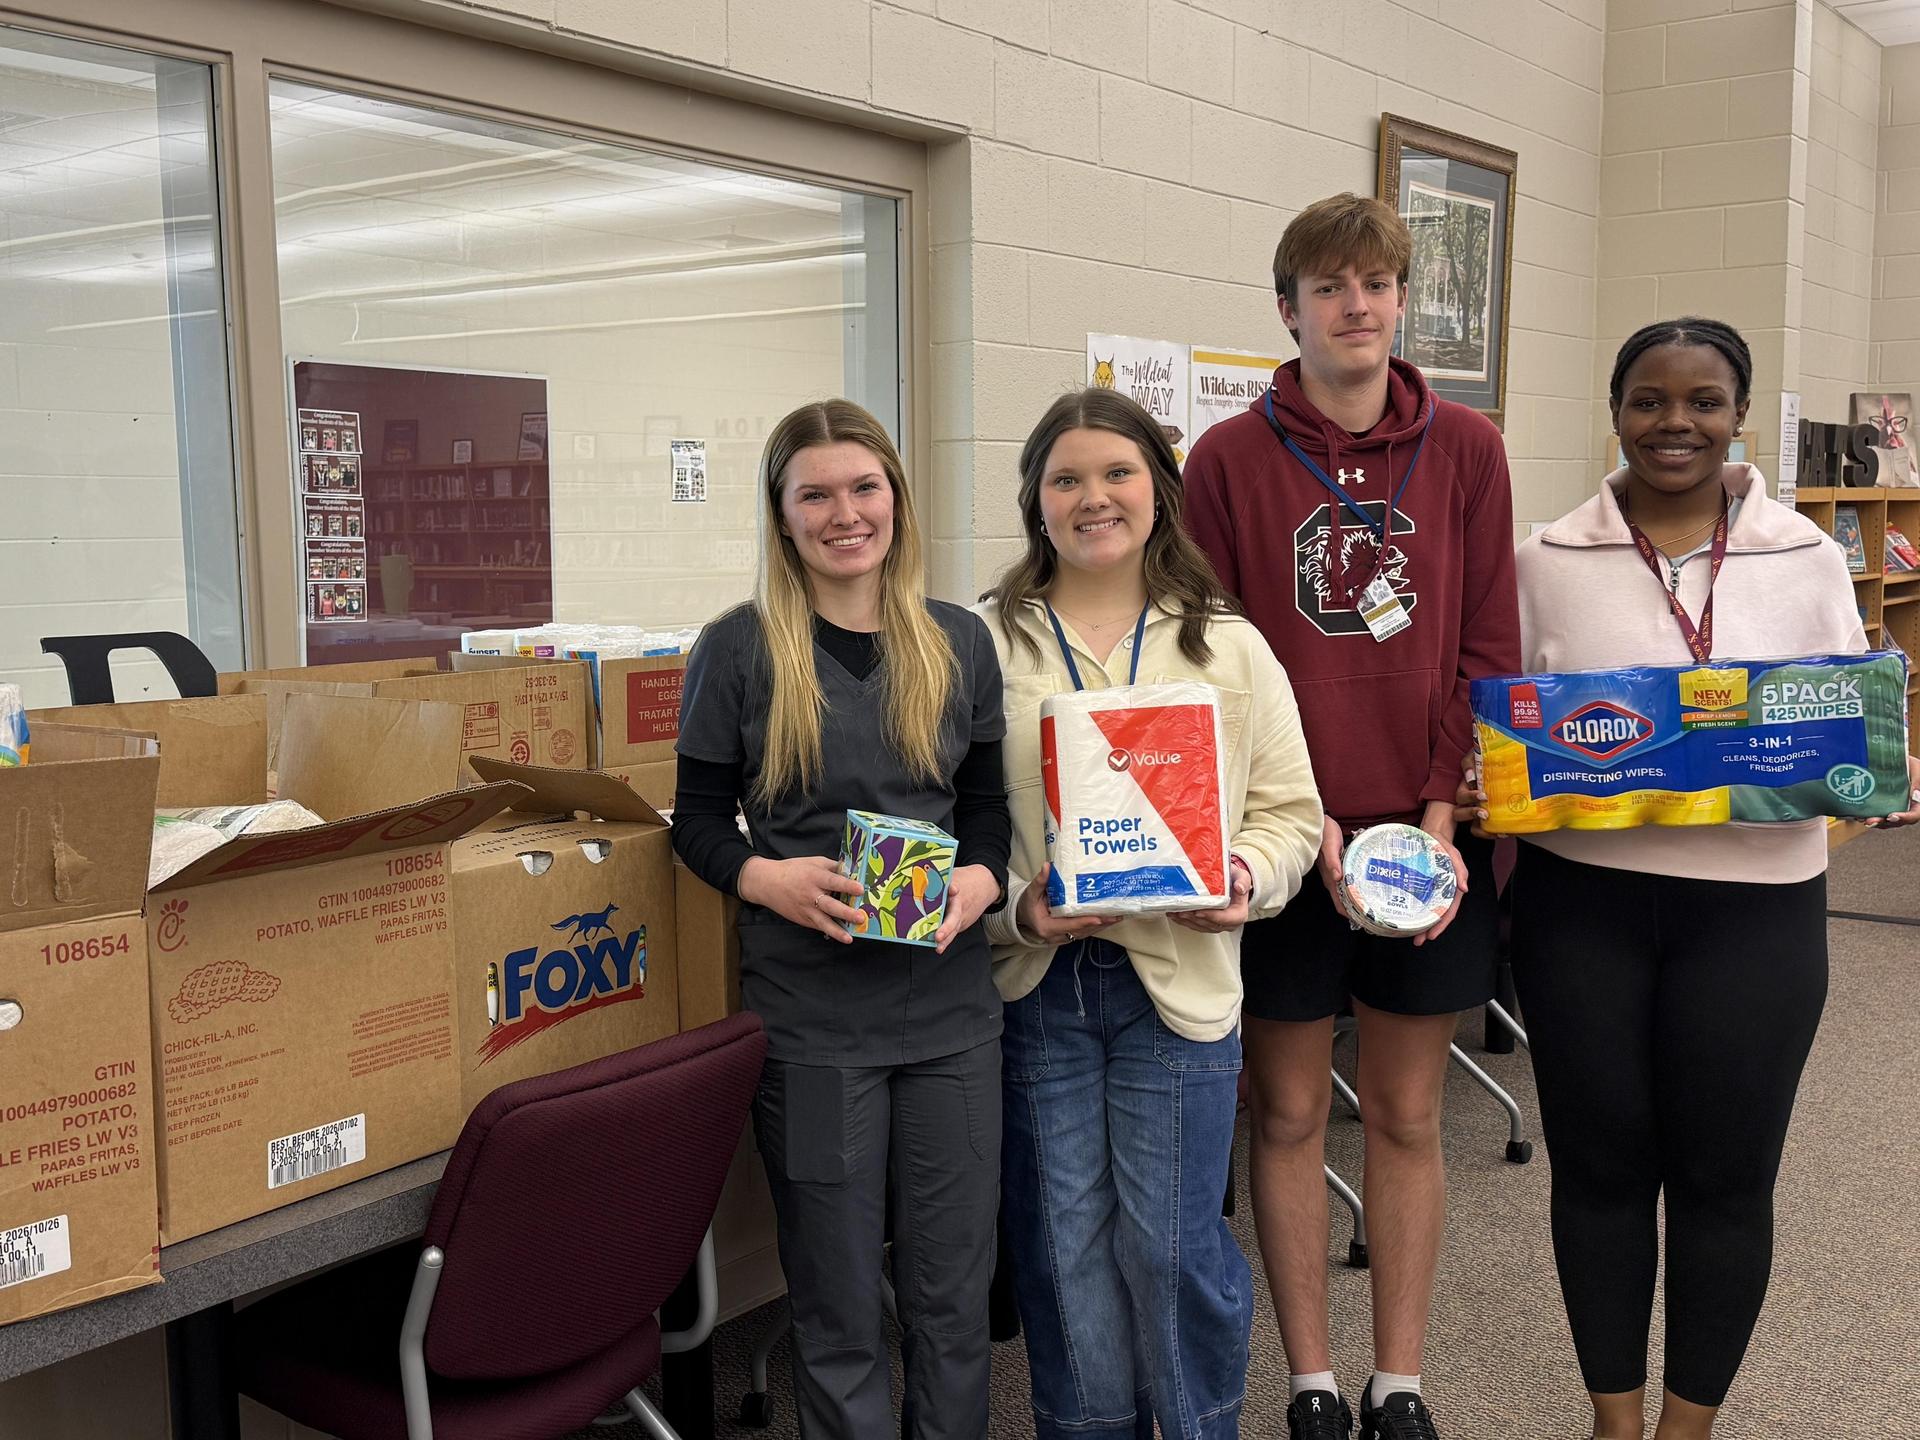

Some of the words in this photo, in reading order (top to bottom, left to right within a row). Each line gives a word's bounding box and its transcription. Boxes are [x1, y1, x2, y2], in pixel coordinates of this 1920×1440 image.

[1122, 365, 1133, 376] The
[1134, 356, 1173, 386] Wildcat
[1200, 376, 1245, 397] Wildcats
[1131, 385, 1174, 415] WAY
[1797, 418, 1879, 488] CATS
[641, 676, 677, 689] HANDLE
[1762, 684, 1778, 704] 5
[1782, 677, 1862, 703] PACK
[658, 690, 682, 701] EGGS
[1693, 690, 1732, 700] NEW
[1695, 698, 1732, 707] SCENTS!
[638, 708, 673, 720] TRATAR
[1514, 708, 1539, 716] 99.9%
[1766, 706, 1797, 721] 425
[1800, 702, 1860, 718] WIPES
[653, 722, 679, 733] HUEV
[1562, 718, 1640, 744] CLOROX
[1748, 736, 1792, 749] 3-IN-1
[1133, 752, 1182, 768] Value
[1750, 763, 1794, 773] FRESHENS
[1762, 750, 1820, 764] DEODORIZES,
[1543, 772, 1623, 784] DISINFECTING
[1079, 817, 1142, 837] Paper
[1080, 834, 1158, 856] Towels
[385, 851, 444, 877] 108654
[318, 892, 349, 910] GTIN
[352, 874, 445, 902] 10044979000682
[1086, 878, 1096, 890] 2
[1387, 901, 1408, 909] BOWLS
[1391, 895, 1406, 904] 32
[256, 920, 314, 942] POTATO,
[318, 907, 369, 929] WAFFLE
[372, 899, 407, 918] FRIES
[410, 895, 428, 910] LW
[431, 892, 446, 904] V3
[380, 915, 410, 930] PAPAS
[412, 908, 447, 922] FRITAS,
[375, 927, 418, 944] WAFFLES
[419, 923, 434, 934] LW
[436, 921, 447, 931] V3
[40, 933, 130, 966] 108654
[504, 930, 642, 1021] FOXY
[164, 1030, 235, 1055] CHICK-FIL-A,
[238, 1024, 259, 1037] INC.
[94, 1060, 136, 1082] GTIN
[164, 1065, 188, 1076] LAMB
[190, 1055, 222, 1070] WESTON
[0, 1082, 136, 1123] 10044979000682
[166, 1096, 188, 1108] CASE
[226, 1083, 236, 1091] LB
[238, 1077, 260, 1088] BAGS
[166, 1108, 183, 1118] NET
[185, 1103, 196, 1114] WT
[208, 1098, 219, 1107] LB
[238, 1089, 250, 1100] kg)
[63, 1104, 137, 1132] POTATO,
[167, 1120, 189, 1133] KEEP
[190, 1112, 221, 1127] FROZEN
[28, 1137, 81, 1162] FRIES
[87, 1130, 112, 1148] LW
[118, 1124, 138, 1140] V3
[168, 1134, 189, 1146] BEST
[190, 1124, 222, 1140] BEFORE
[223, 1119, 243, 1130] DATE
[271, 1138, 289, 1152] BEST
[292, 1129, 320, 1146] BEFORE
[322, 1118, 358, 1138] 2026/07/02
[41, 1155, 85, 1175] PAPAS
[89, 1143, 139, 1164] FRITAS,
[32, 1169, 97, 1192] WAFFLES
[101, 1163, 120, 1177] LW
[124, 1159, 140, 1171] V3
[6, 1218, 60, 1242] 2026/10/26
[26, 1237, 33, 1247] A
